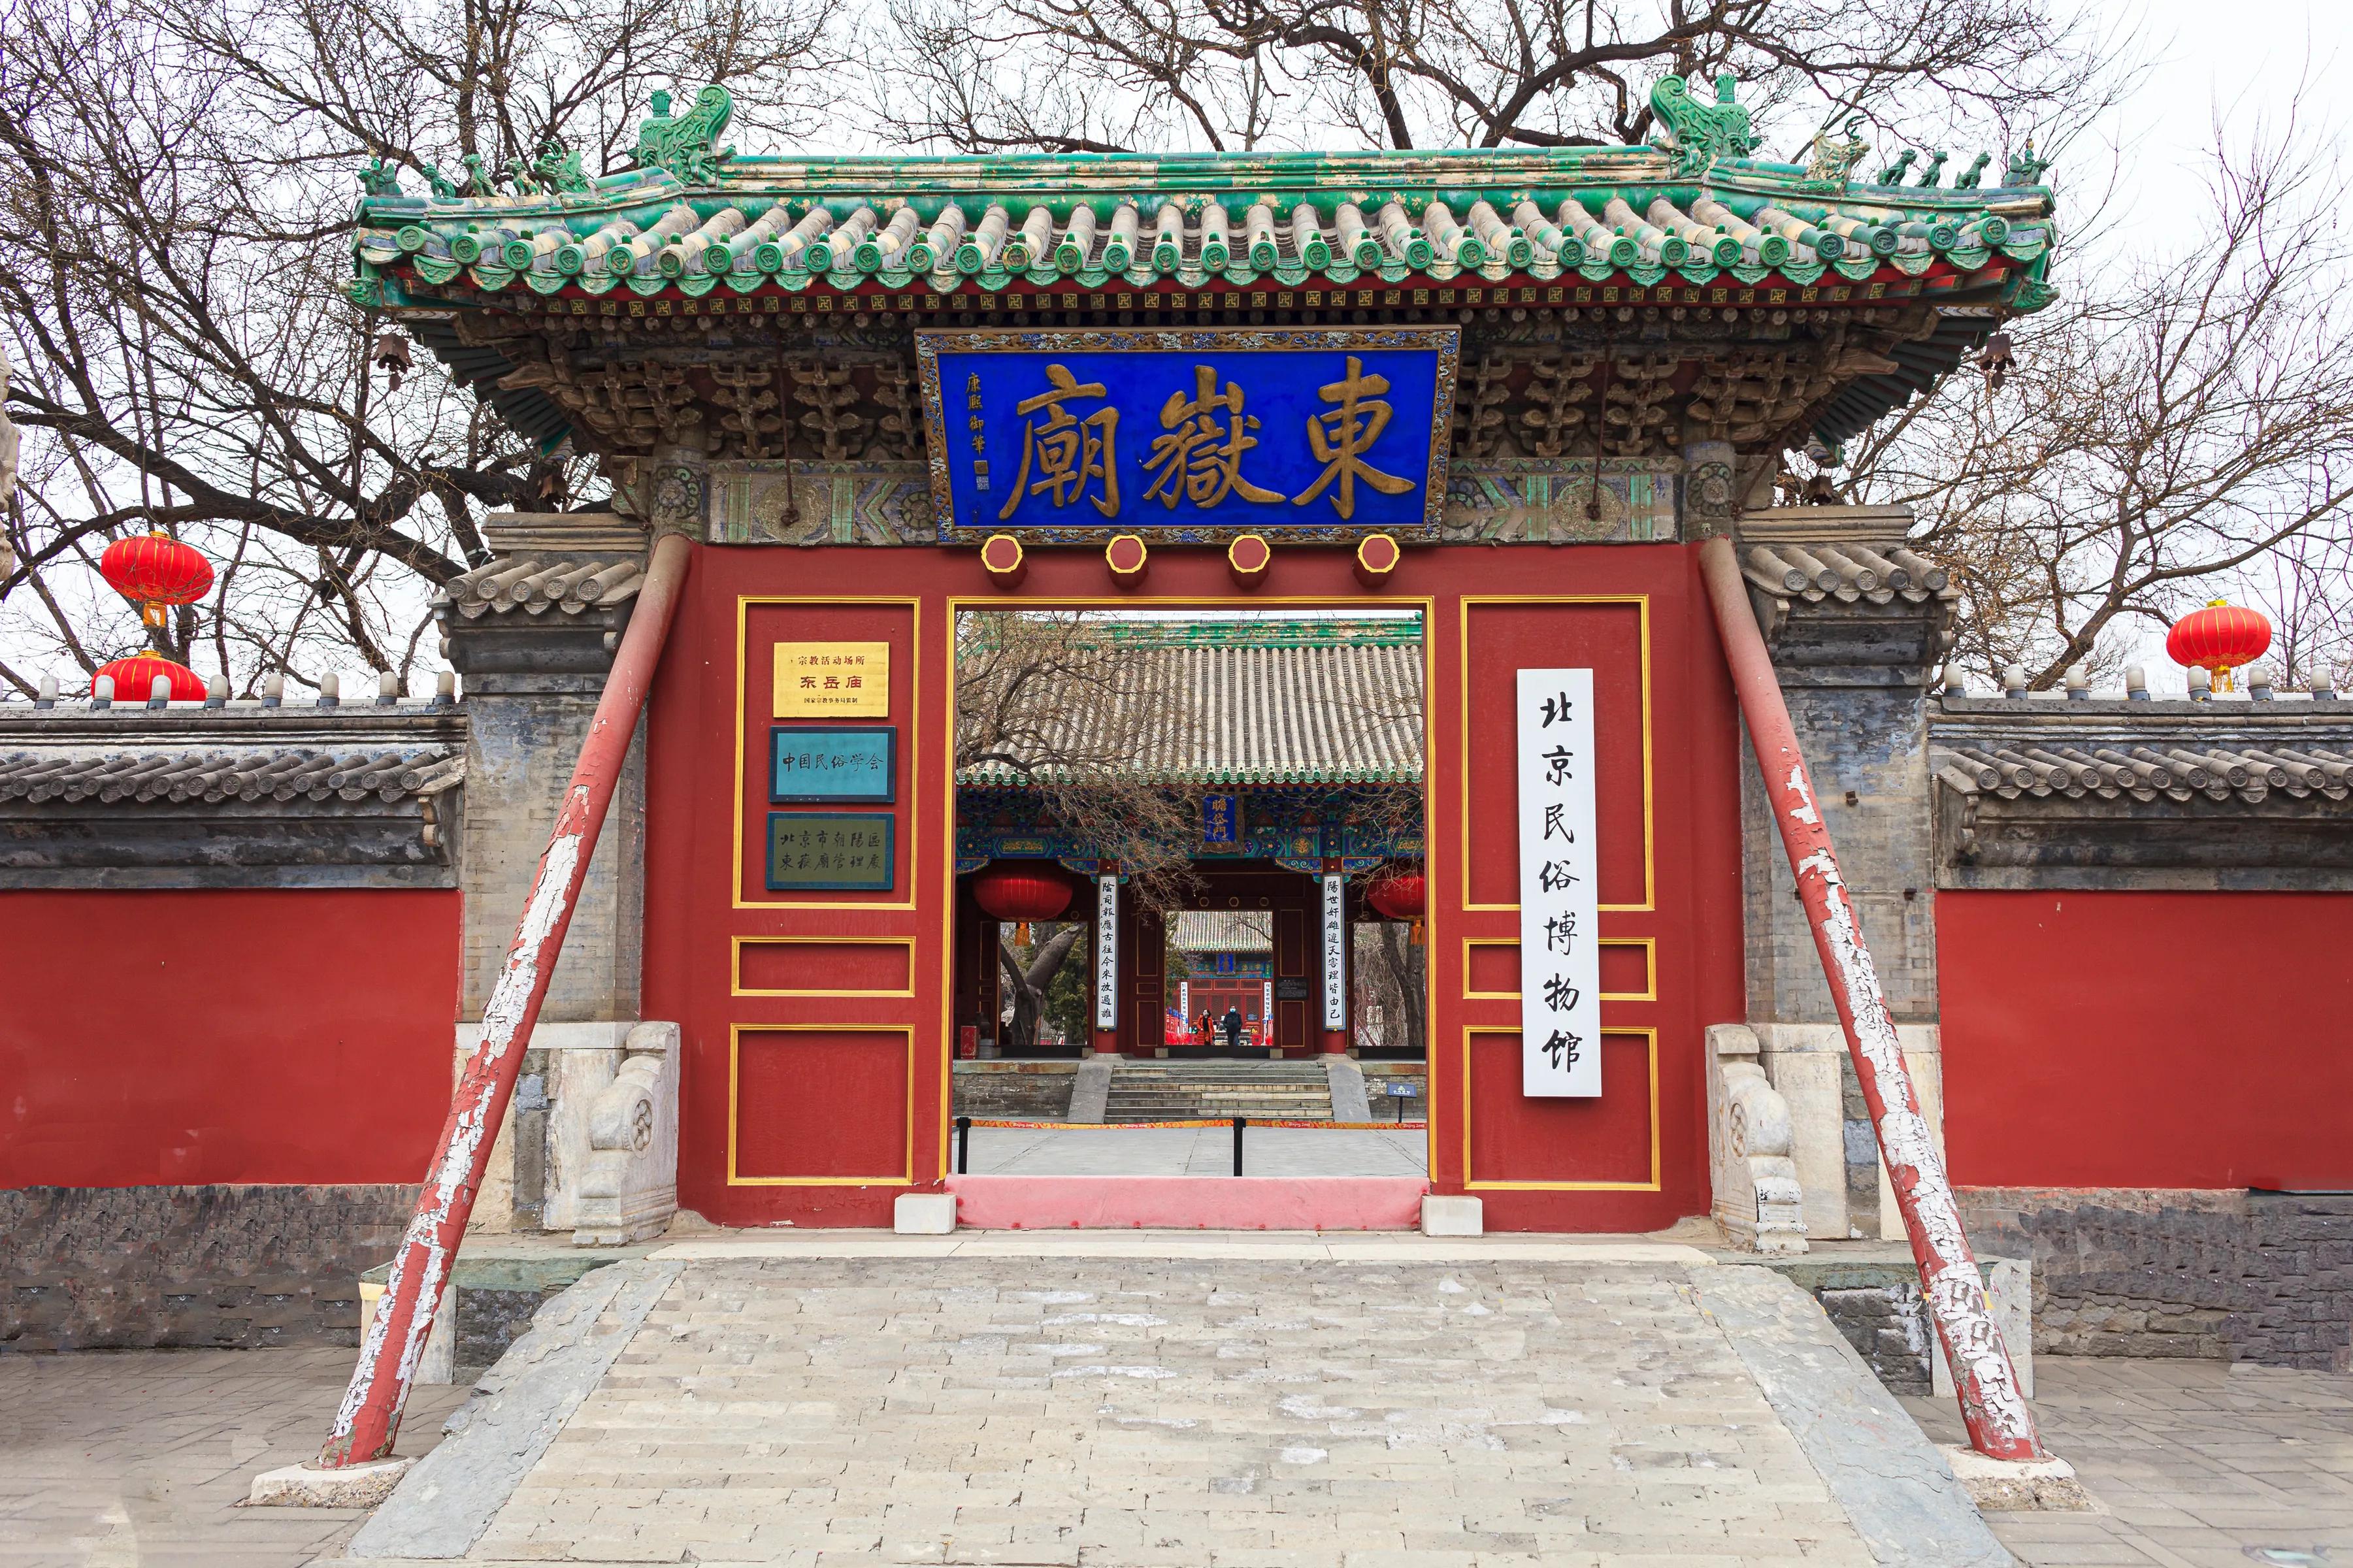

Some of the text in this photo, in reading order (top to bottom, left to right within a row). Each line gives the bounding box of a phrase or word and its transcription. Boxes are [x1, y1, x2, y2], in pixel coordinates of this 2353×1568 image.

[798, 655, 865, 665] 宗教活动场所
[800, 676, 863, 689] 东岳庙
[783, 752, 883, 772] 中国民俗学会
[780, 830, 880, 849] 北京市朝陽區
[1539, 692, 1583, 1073] 北京民俗博物馆
